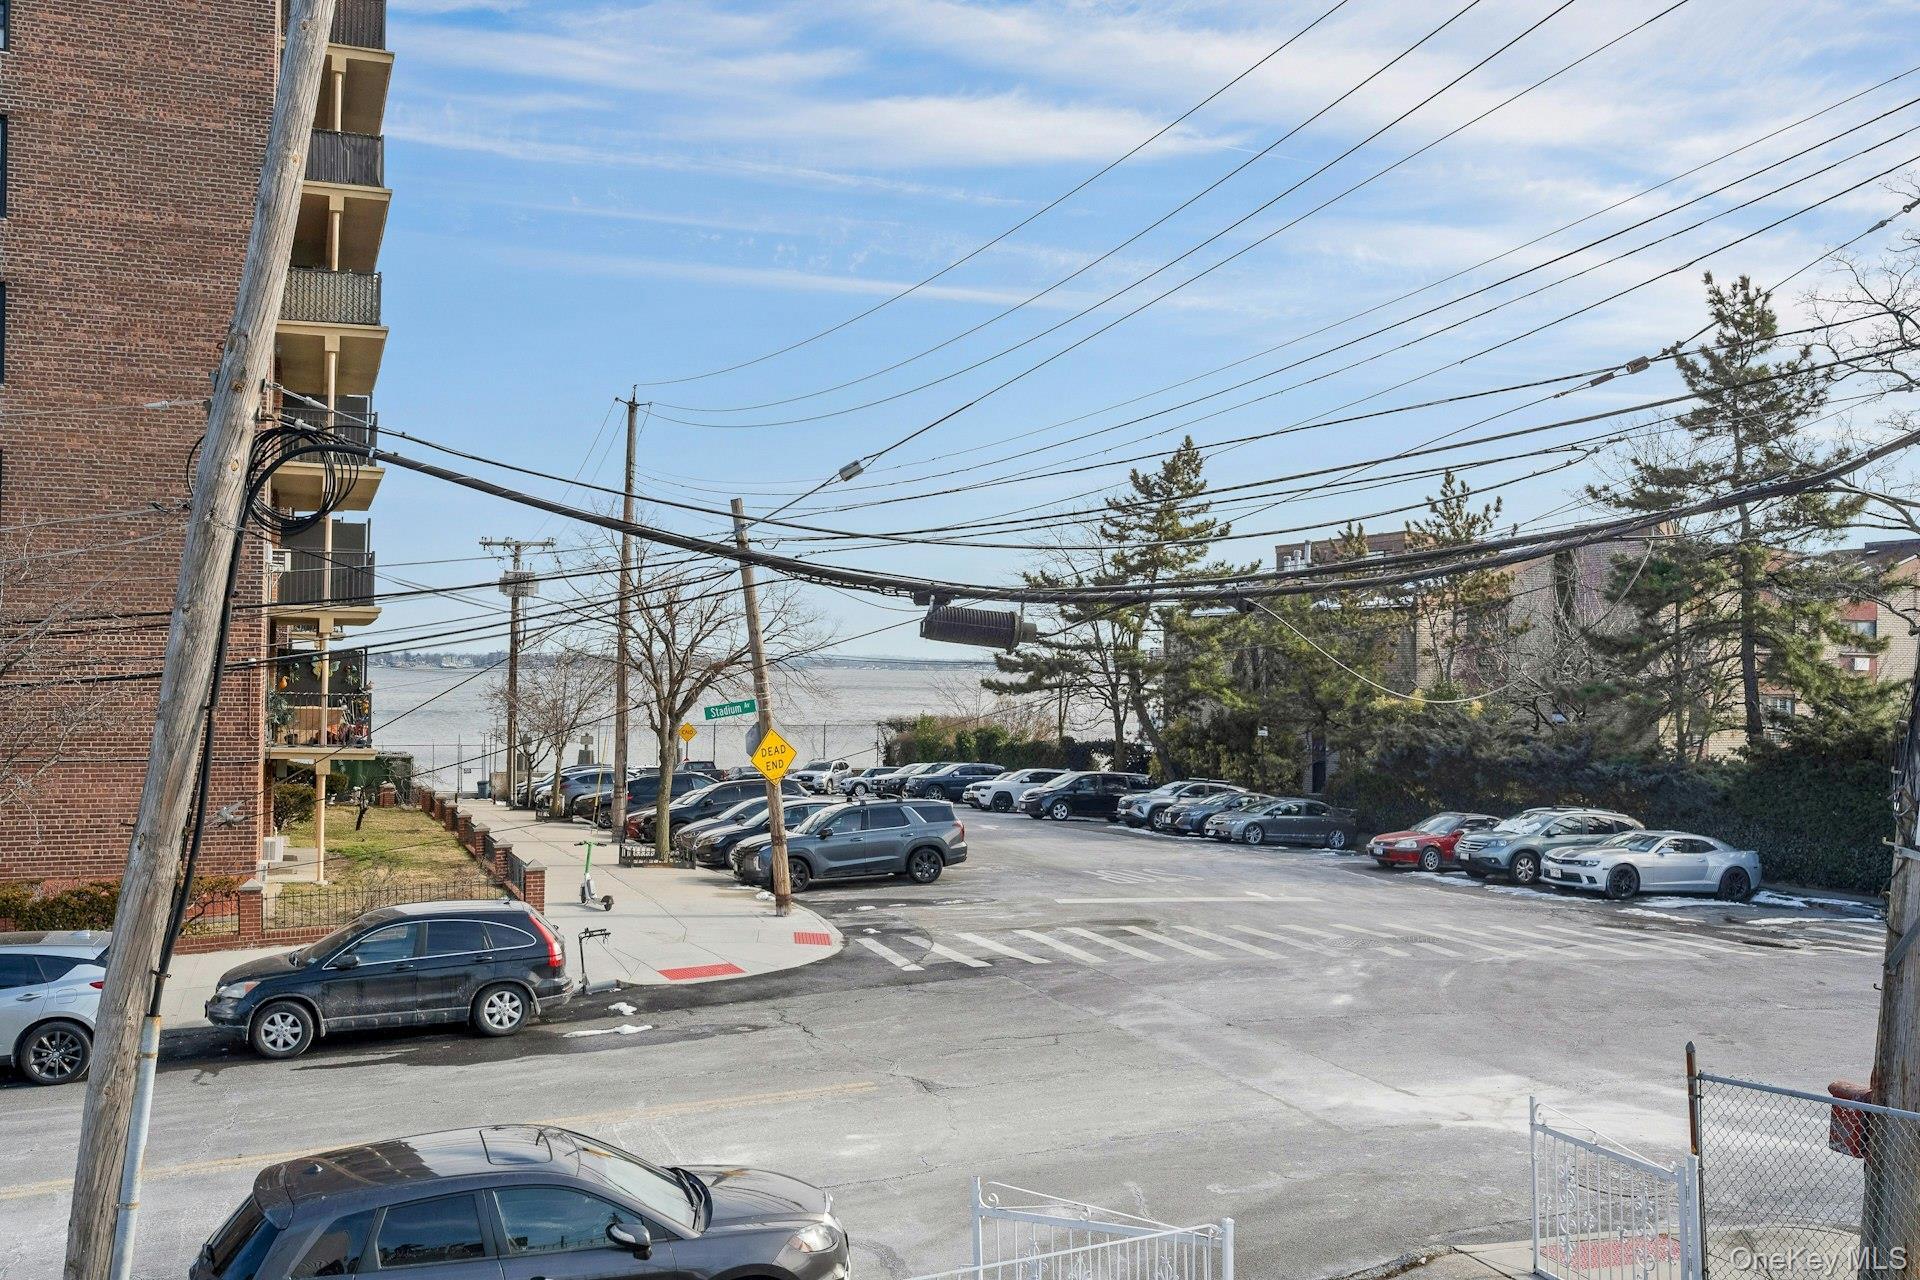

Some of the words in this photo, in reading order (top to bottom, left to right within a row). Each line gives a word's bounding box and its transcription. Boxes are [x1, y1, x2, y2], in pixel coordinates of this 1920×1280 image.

[711, 705, 742, 718] Stadium
[761, 745, 786, 758] DEAD
[766, 760, 784, 771] END
